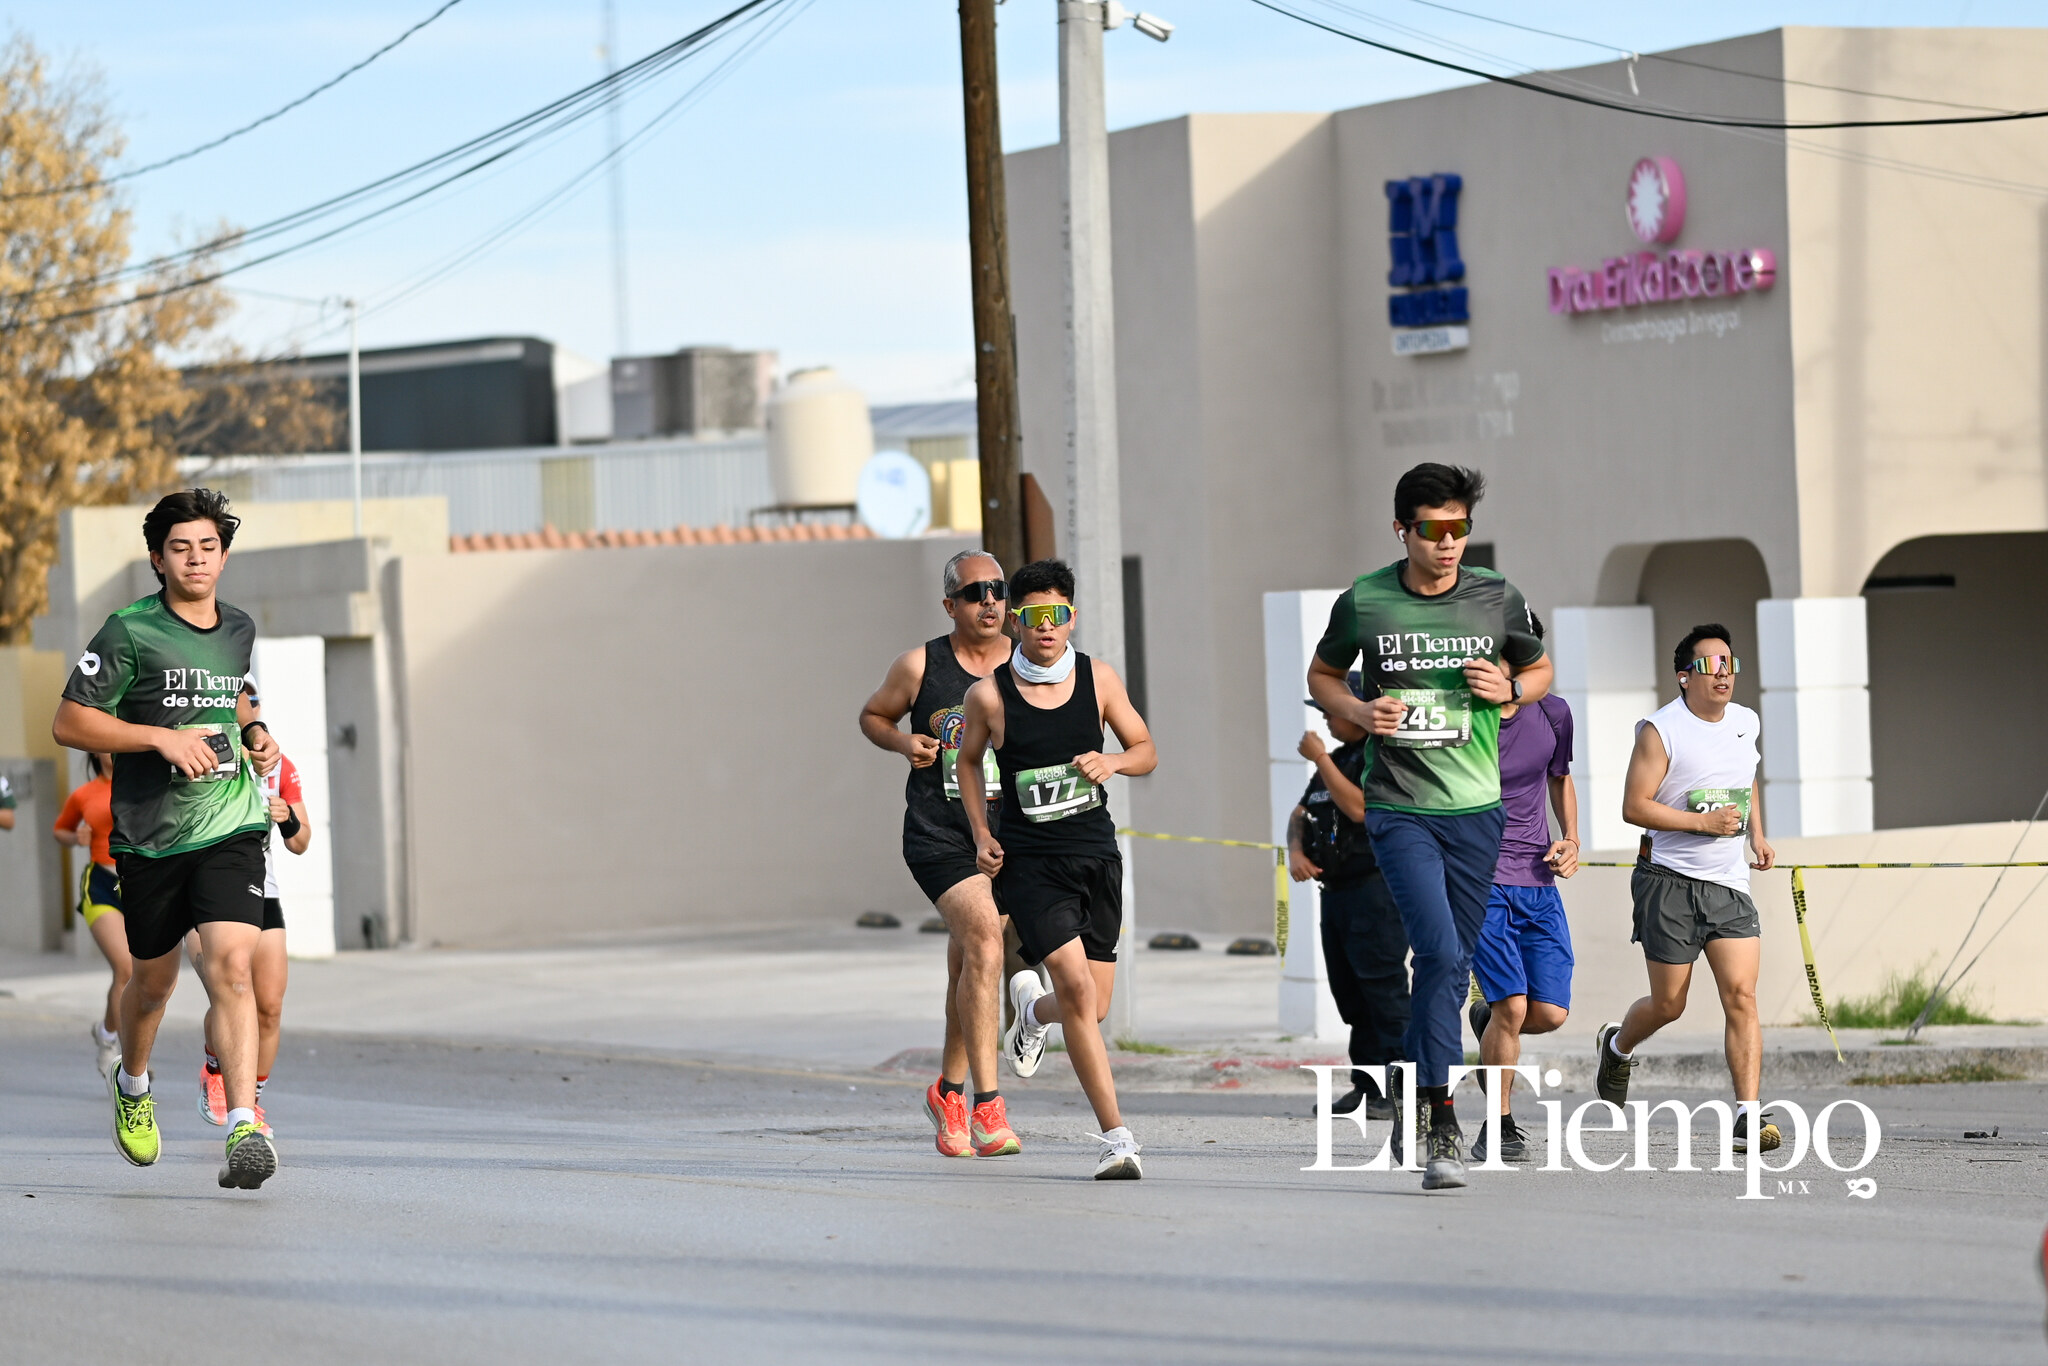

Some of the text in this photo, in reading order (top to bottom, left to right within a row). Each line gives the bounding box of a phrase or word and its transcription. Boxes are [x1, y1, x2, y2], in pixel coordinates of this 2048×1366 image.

[1376, 632, 1493, 657] El Tiempo
[1381, 658, 1407, 673] de
[163, 668, 245, 697] El Tiemp
[162, 693, 237, 709] de todos
[1461, 701, 1470, 741] MEDALLA
[1028, 776, 1079, 806] 177
